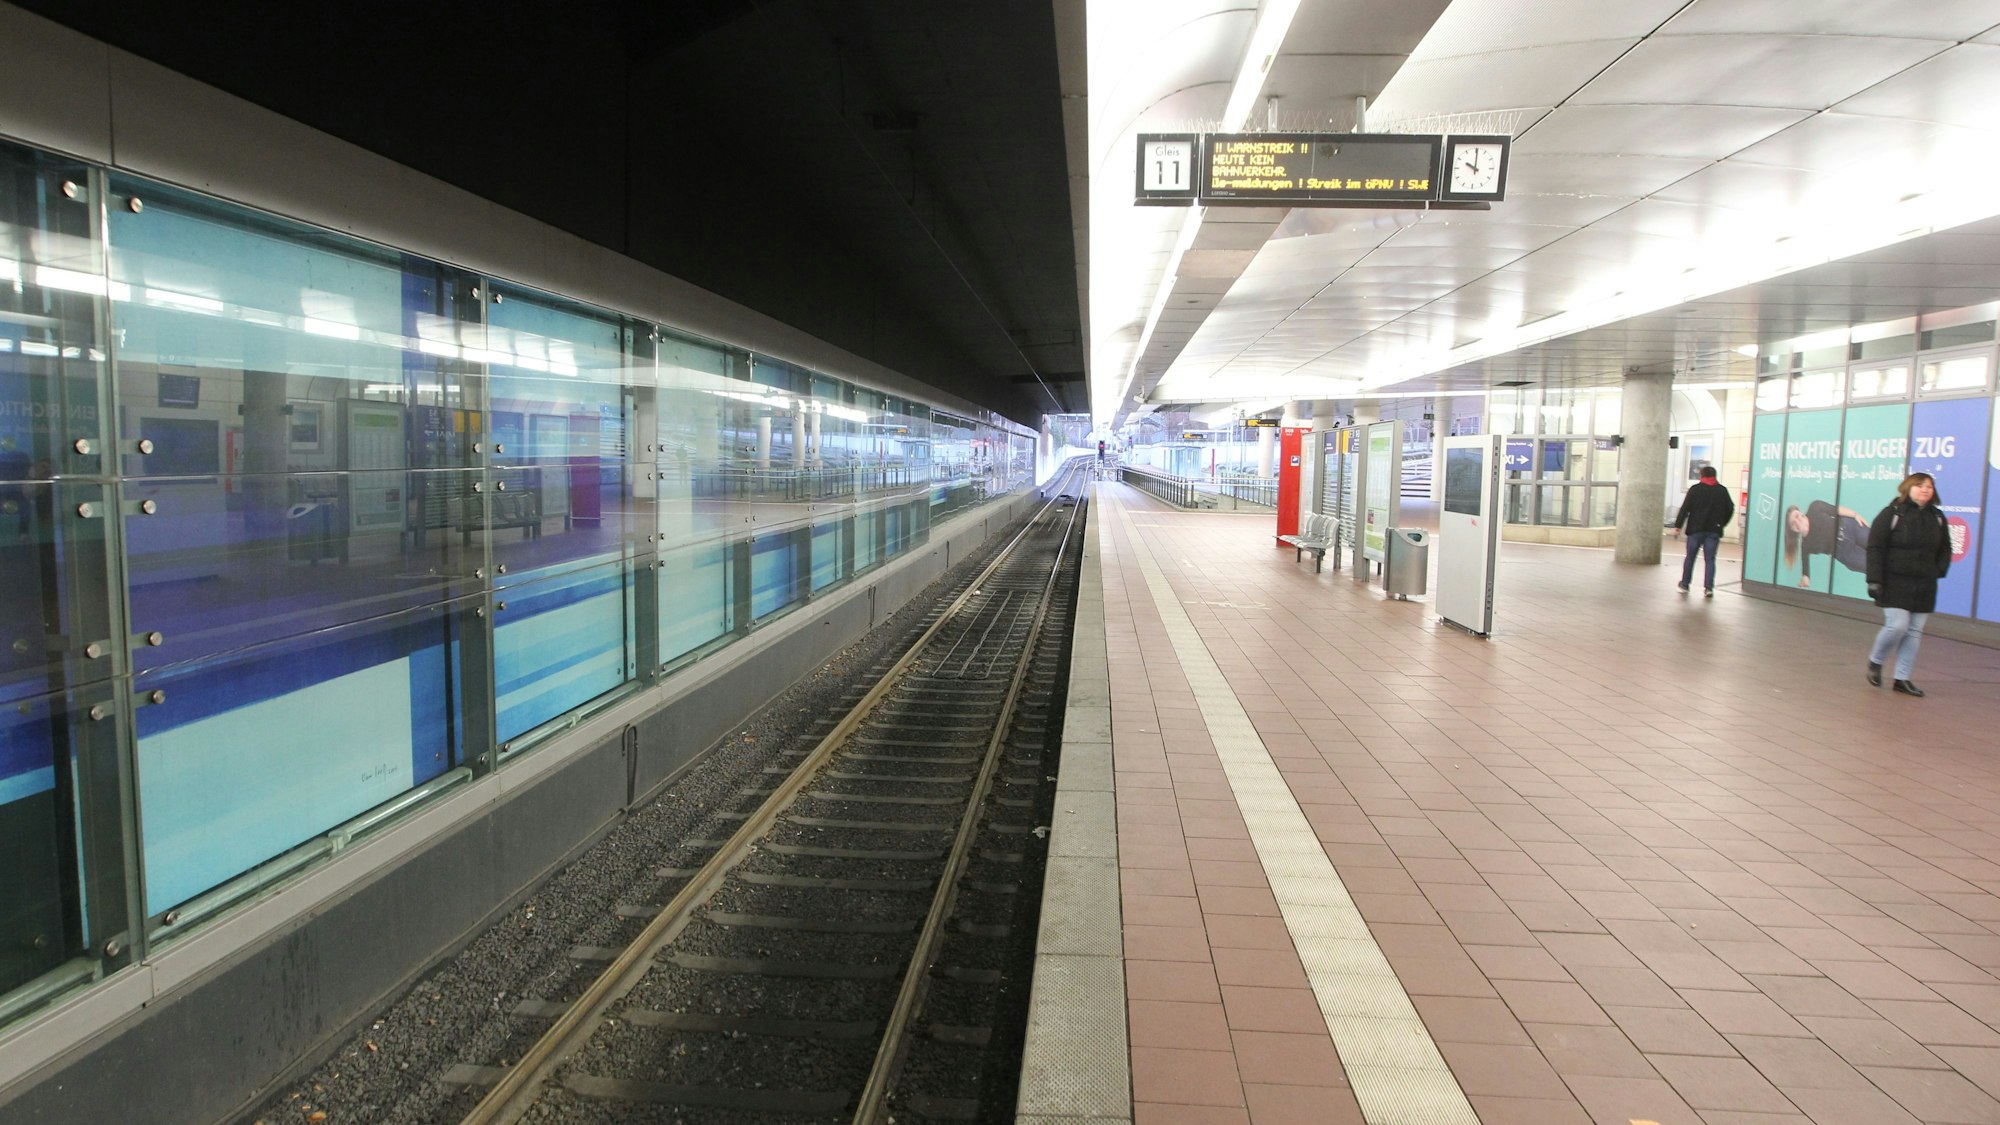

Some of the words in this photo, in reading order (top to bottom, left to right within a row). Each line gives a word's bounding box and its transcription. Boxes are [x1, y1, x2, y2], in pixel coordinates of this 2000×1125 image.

[1155, 144, 1180, 157] Gleis
[1227, 142, 1294, 154] WARNSTREIK
[1212, 154, 1245, 165] HEUTE
[1249, 154, 1275, 165] KEIN
[1155, 160, 1180, 185] 11
[1212, 166, 1287, 177] BAHNVERKEHR.
[1307, 178, 1342, 189] Streik
[1346, 179, 1361, 189] im
[1760, 443, 1781, 460] EIN
[1786, 440, 1841, 459] RICHTIG
[1846, 438, 1907, 459] KLUGER
[1914, 436, 1955, 458] ZUG
